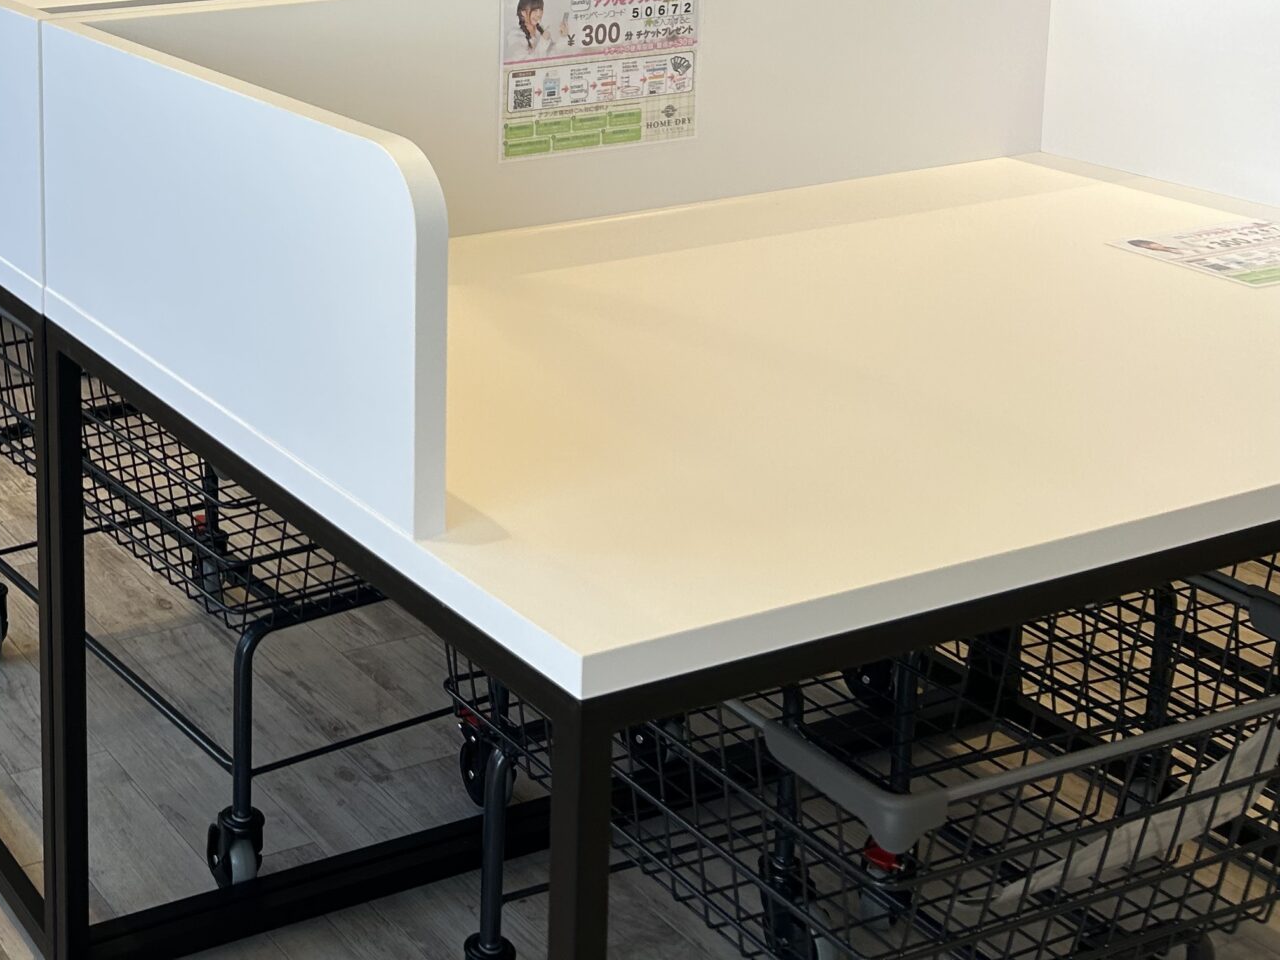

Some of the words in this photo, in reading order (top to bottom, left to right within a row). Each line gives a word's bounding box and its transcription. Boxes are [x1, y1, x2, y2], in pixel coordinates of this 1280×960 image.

[574, 9, 625, 20] キャンペーンコード
[582, 22, 620, 46] 300
[625, 31, 633, 40] 分
[636, 26, 694, 39] チケットプレゼント
[646, 120, 670, 129] HOME
[675, 117, 692, 126] DRY
